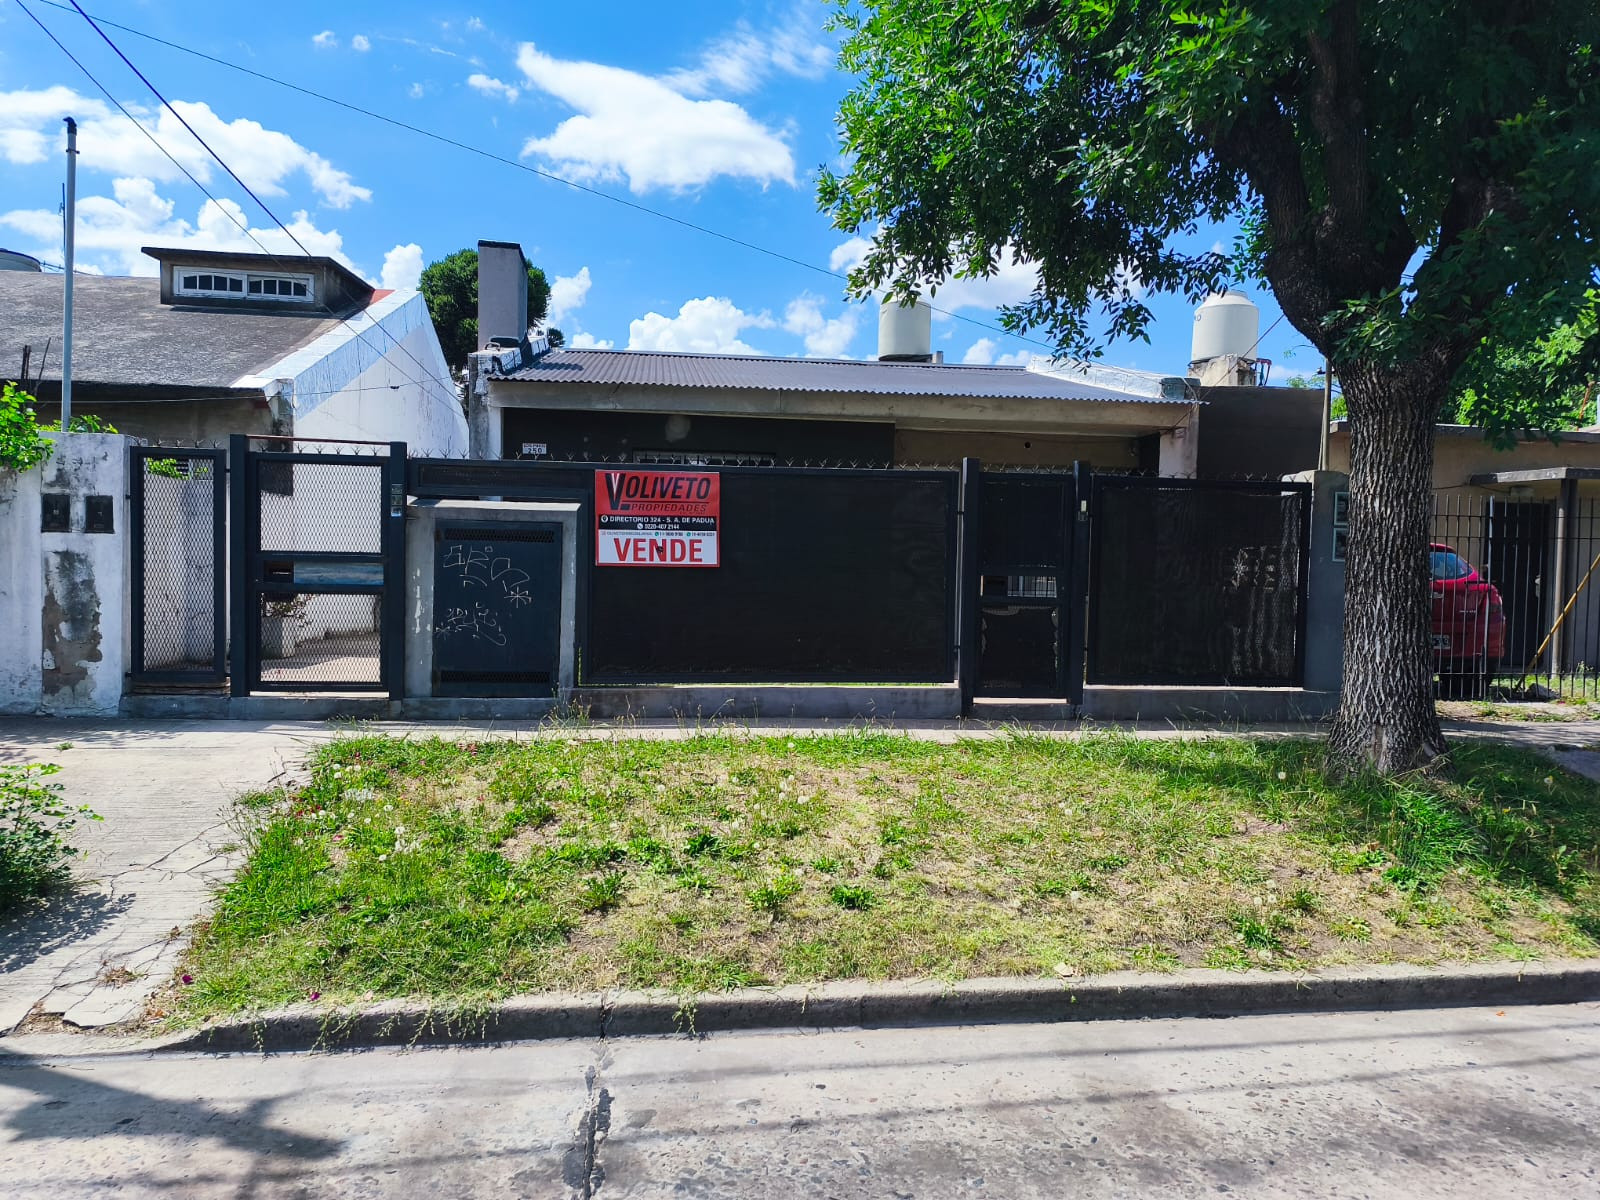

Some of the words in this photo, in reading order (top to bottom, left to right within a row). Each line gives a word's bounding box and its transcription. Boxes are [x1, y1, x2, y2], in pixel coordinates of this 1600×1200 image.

[605, 472, 711, 510] VOLIVETO
[631, 503, 707, 512] PROPIEDADES
[609, 515, 649, 523] DIRECTORIO
[613, 538, 703, 562] VENDE
